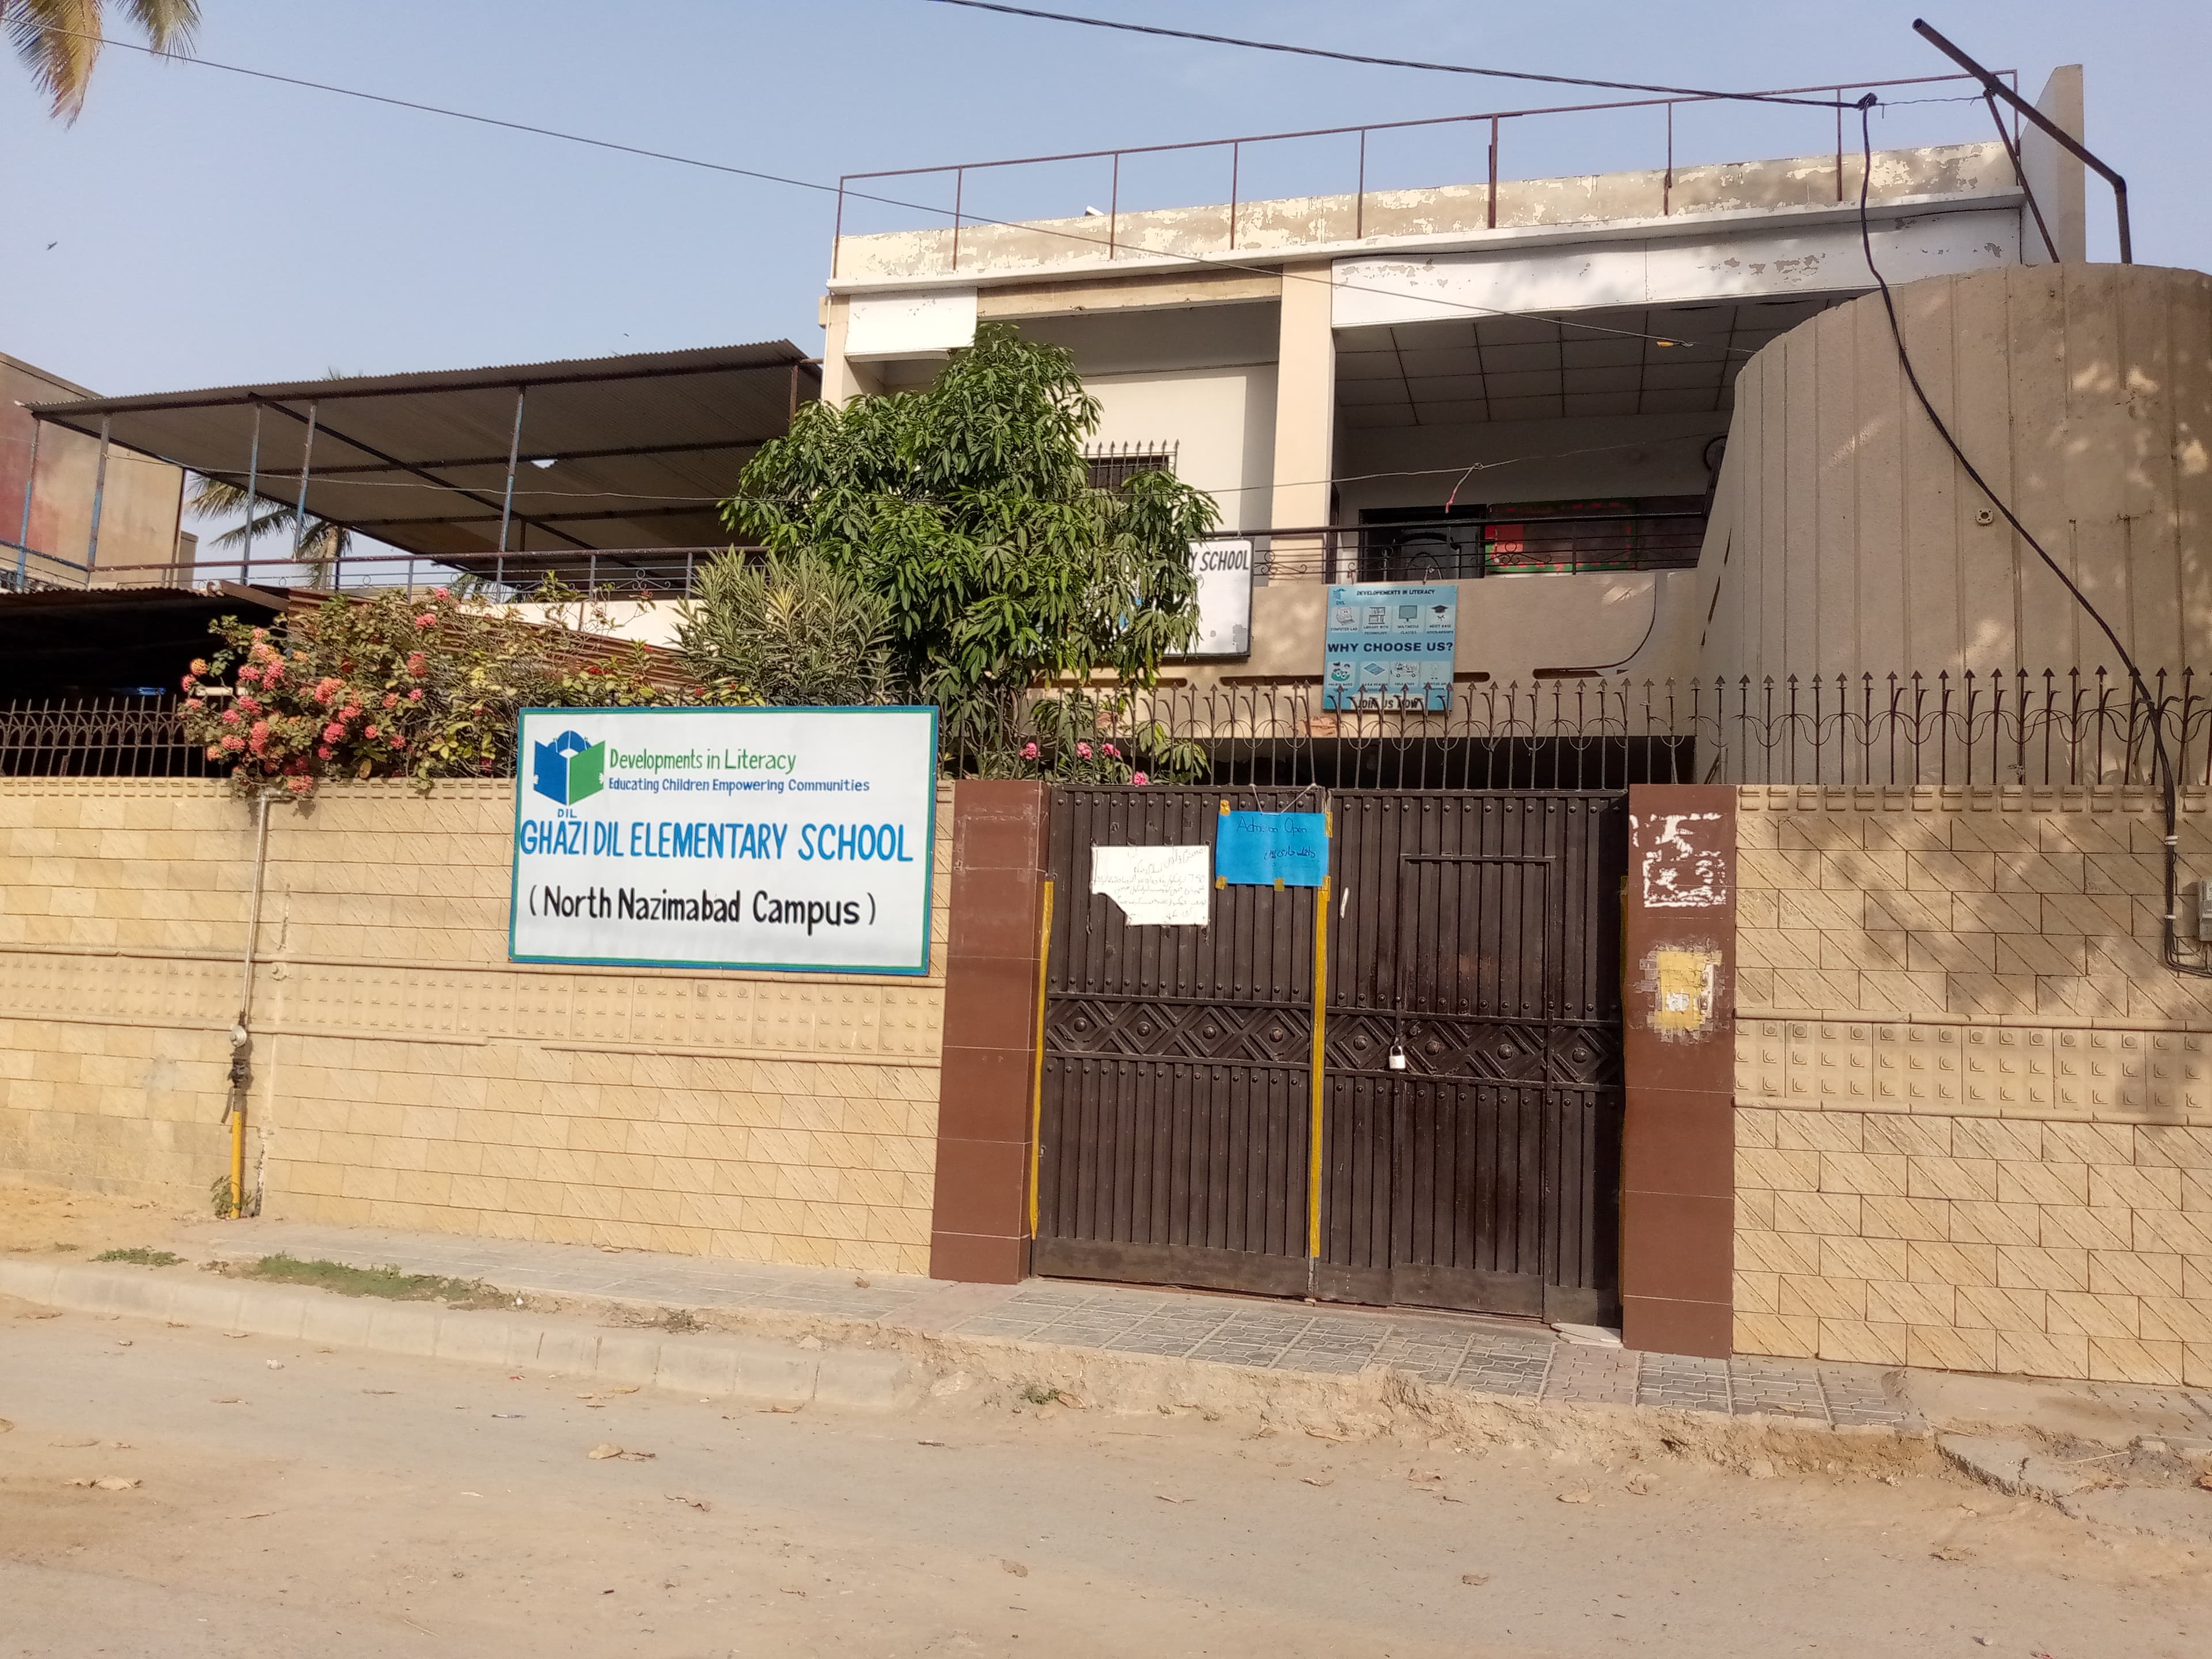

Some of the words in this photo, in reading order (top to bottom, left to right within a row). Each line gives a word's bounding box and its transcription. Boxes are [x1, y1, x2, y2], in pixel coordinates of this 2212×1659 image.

[1199, 550, 1249, 571] SCHOOL
[1327, 643, 1359, 652] WHY
[1363, 642, 1421, 652] CHOOSE
[1427, 642, 1453, 652] US?
[609, 748, 702, 774] Developments
[707, 749, 720, 770] in
[725, 748, 796, 774] Literacy
[609, 778, 659, 793] Educating
[662, 778, 710, 791] Children
[713, 779, 784, 796] Empowering
[789, 779, 870, 791] Communities
[557, 809, 577, 818] DIL
[1284, 817, 1308, 837] Open
[520, 819, 588, 855] GHAZI
[593, 821, 624, 857] DIL
[631, 821, 788, 859] ELEMENTARY
[798, 823, 914, 862] SCHOOL
[618, 888, 740, 922] Nazimabad
